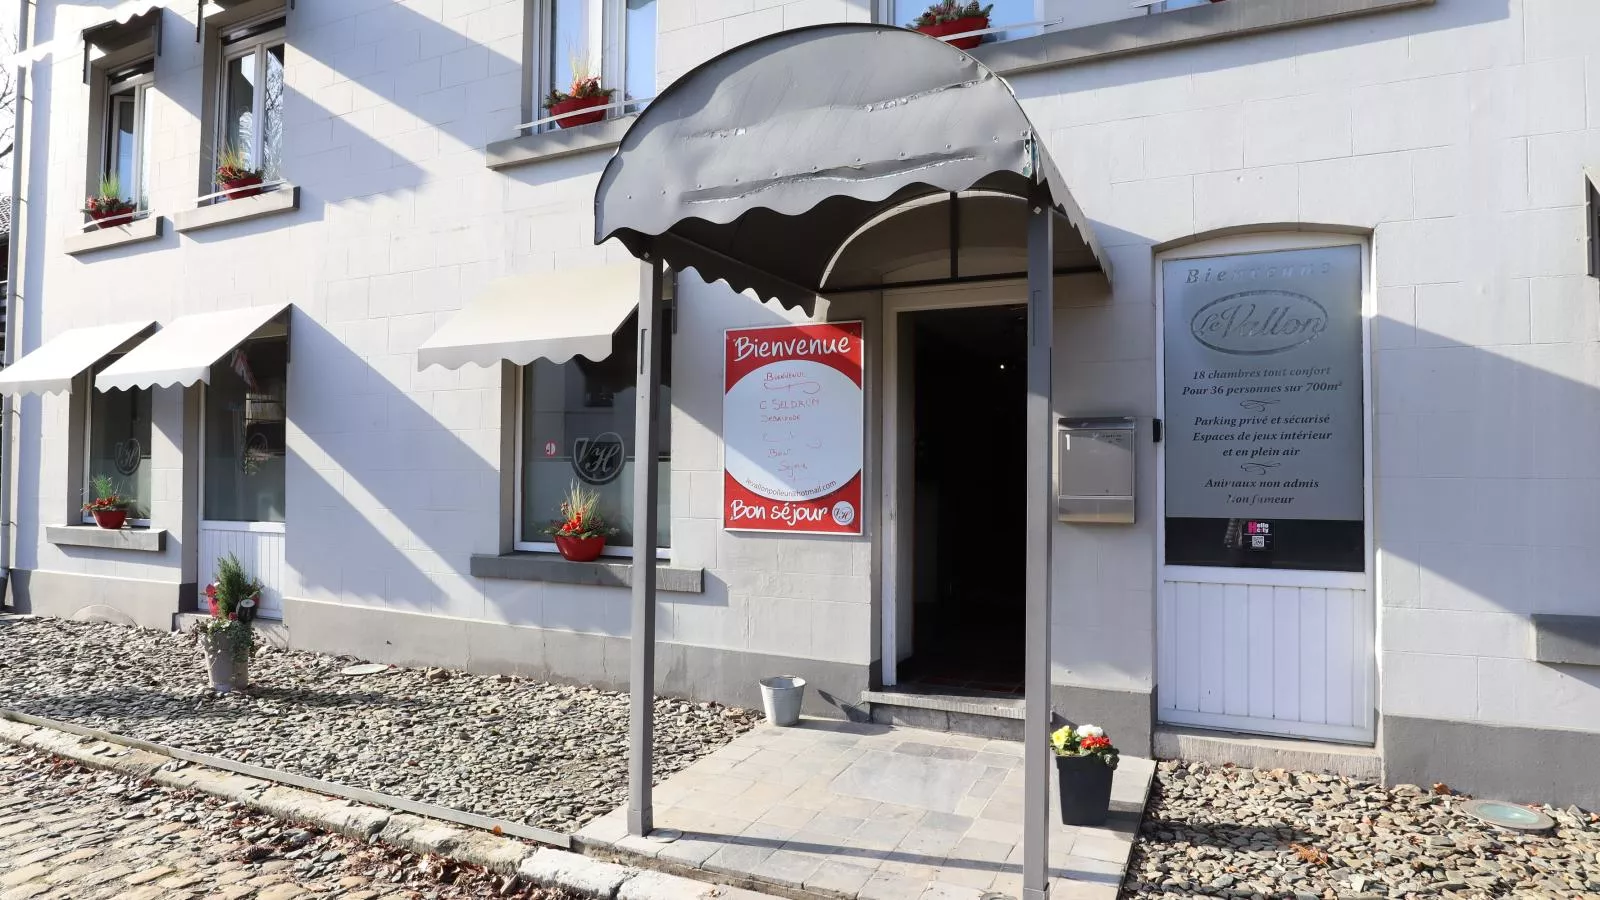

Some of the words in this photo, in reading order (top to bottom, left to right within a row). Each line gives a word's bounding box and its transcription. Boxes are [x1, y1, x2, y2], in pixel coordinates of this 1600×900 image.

[733, 336, 851, 362] Bienvenue
[1193, 371, 1205, 380] 18
[1208, 368, 1261, 379] chambres
[1263, 369, 1287, 377] tout
[1290, 367, 1331, 376] confort
[1182, 386, 1208, 395] Pour
[1210, 386, 1224, 395] 36
[1226, 385, 1282, 396] personnes
[1284, 384, 1303, 393] sur
[1194, 416, 1237, 427] Parking
[1239, 416, 1268, 428] privé
[1270, 416, 1282, 425] et
[1284, 413, 1331, 424] sécurisé
[1192, 432, 1235, 444] Espaces
[1237, 431, 1251, 441] de
[1252, 432, 1278, 443] jeux
[1280, 430, 1333, 441] intérieur
[1222, 448, 1233, 457] et
[1235, 448, 1249, 456] en
[1250, 447, 1280, 459] plein
[1282, 447, 1301, 455] air
[1259, 479, 1281, 488] non
[1283, 478, 1320, 488] admis
[730, 499, 766, 520] Bon
[770, 503, 828, 526] séjour
